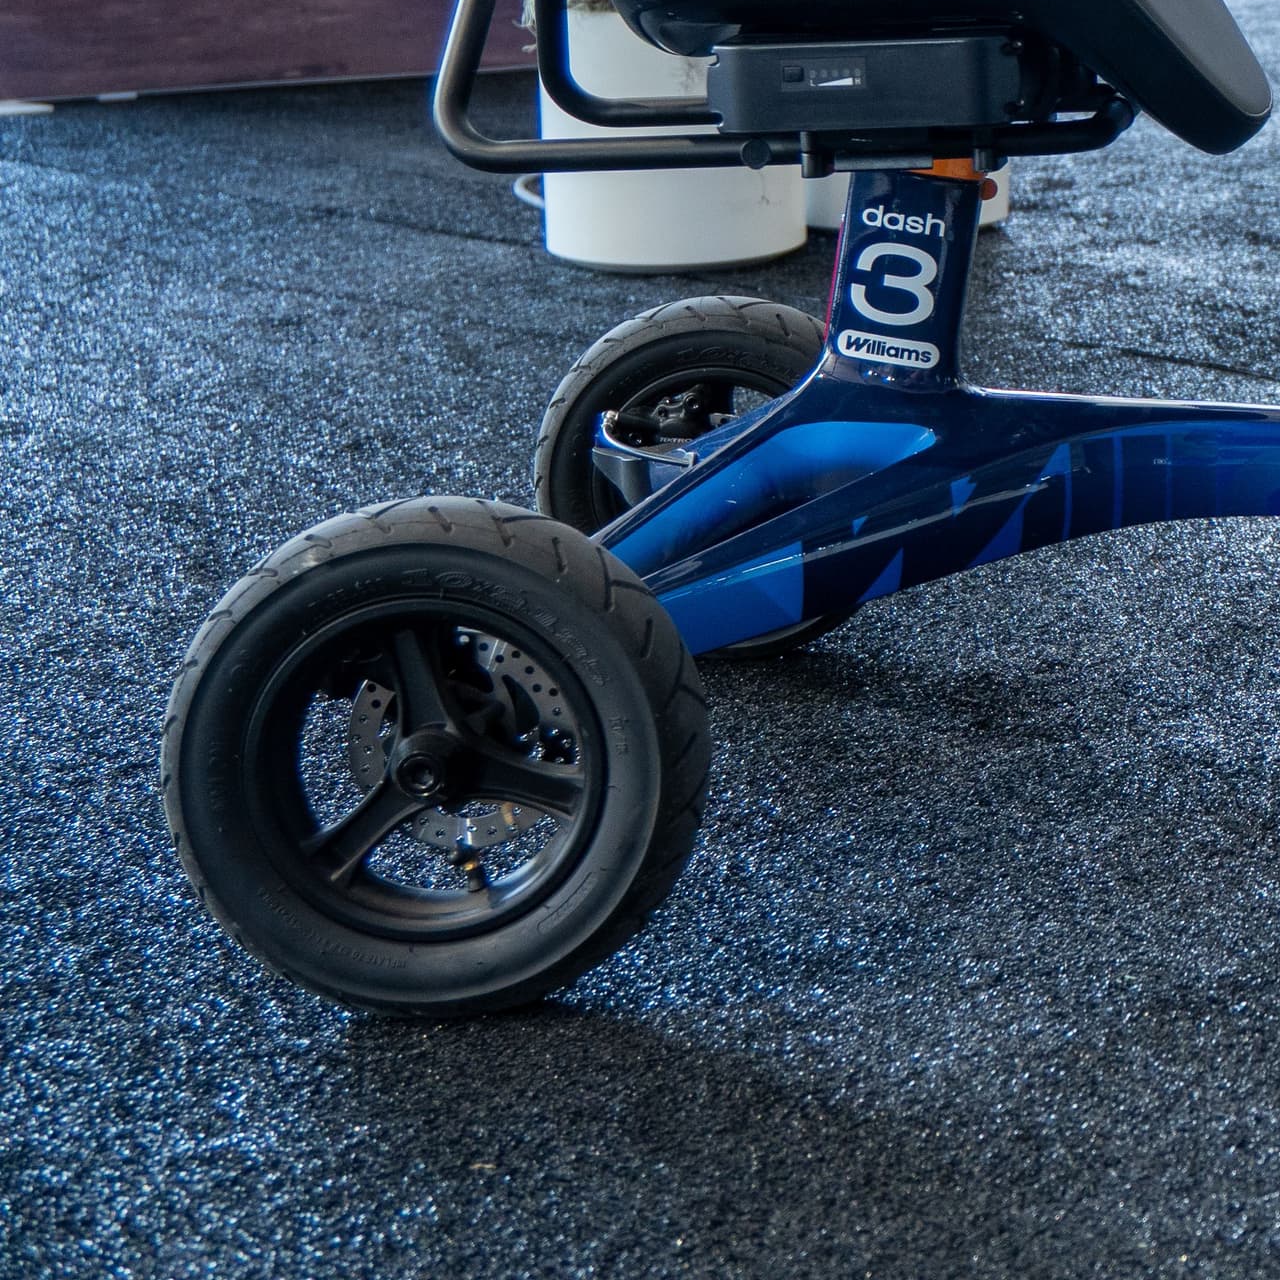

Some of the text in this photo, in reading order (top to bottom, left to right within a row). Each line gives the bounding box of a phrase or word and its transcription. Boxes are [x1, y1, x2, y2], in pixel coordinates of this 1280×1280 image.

[862, 204, 946, 238] dash
[850, 241, 938, 326] 3
[845, 334, 933, 364] Williams
